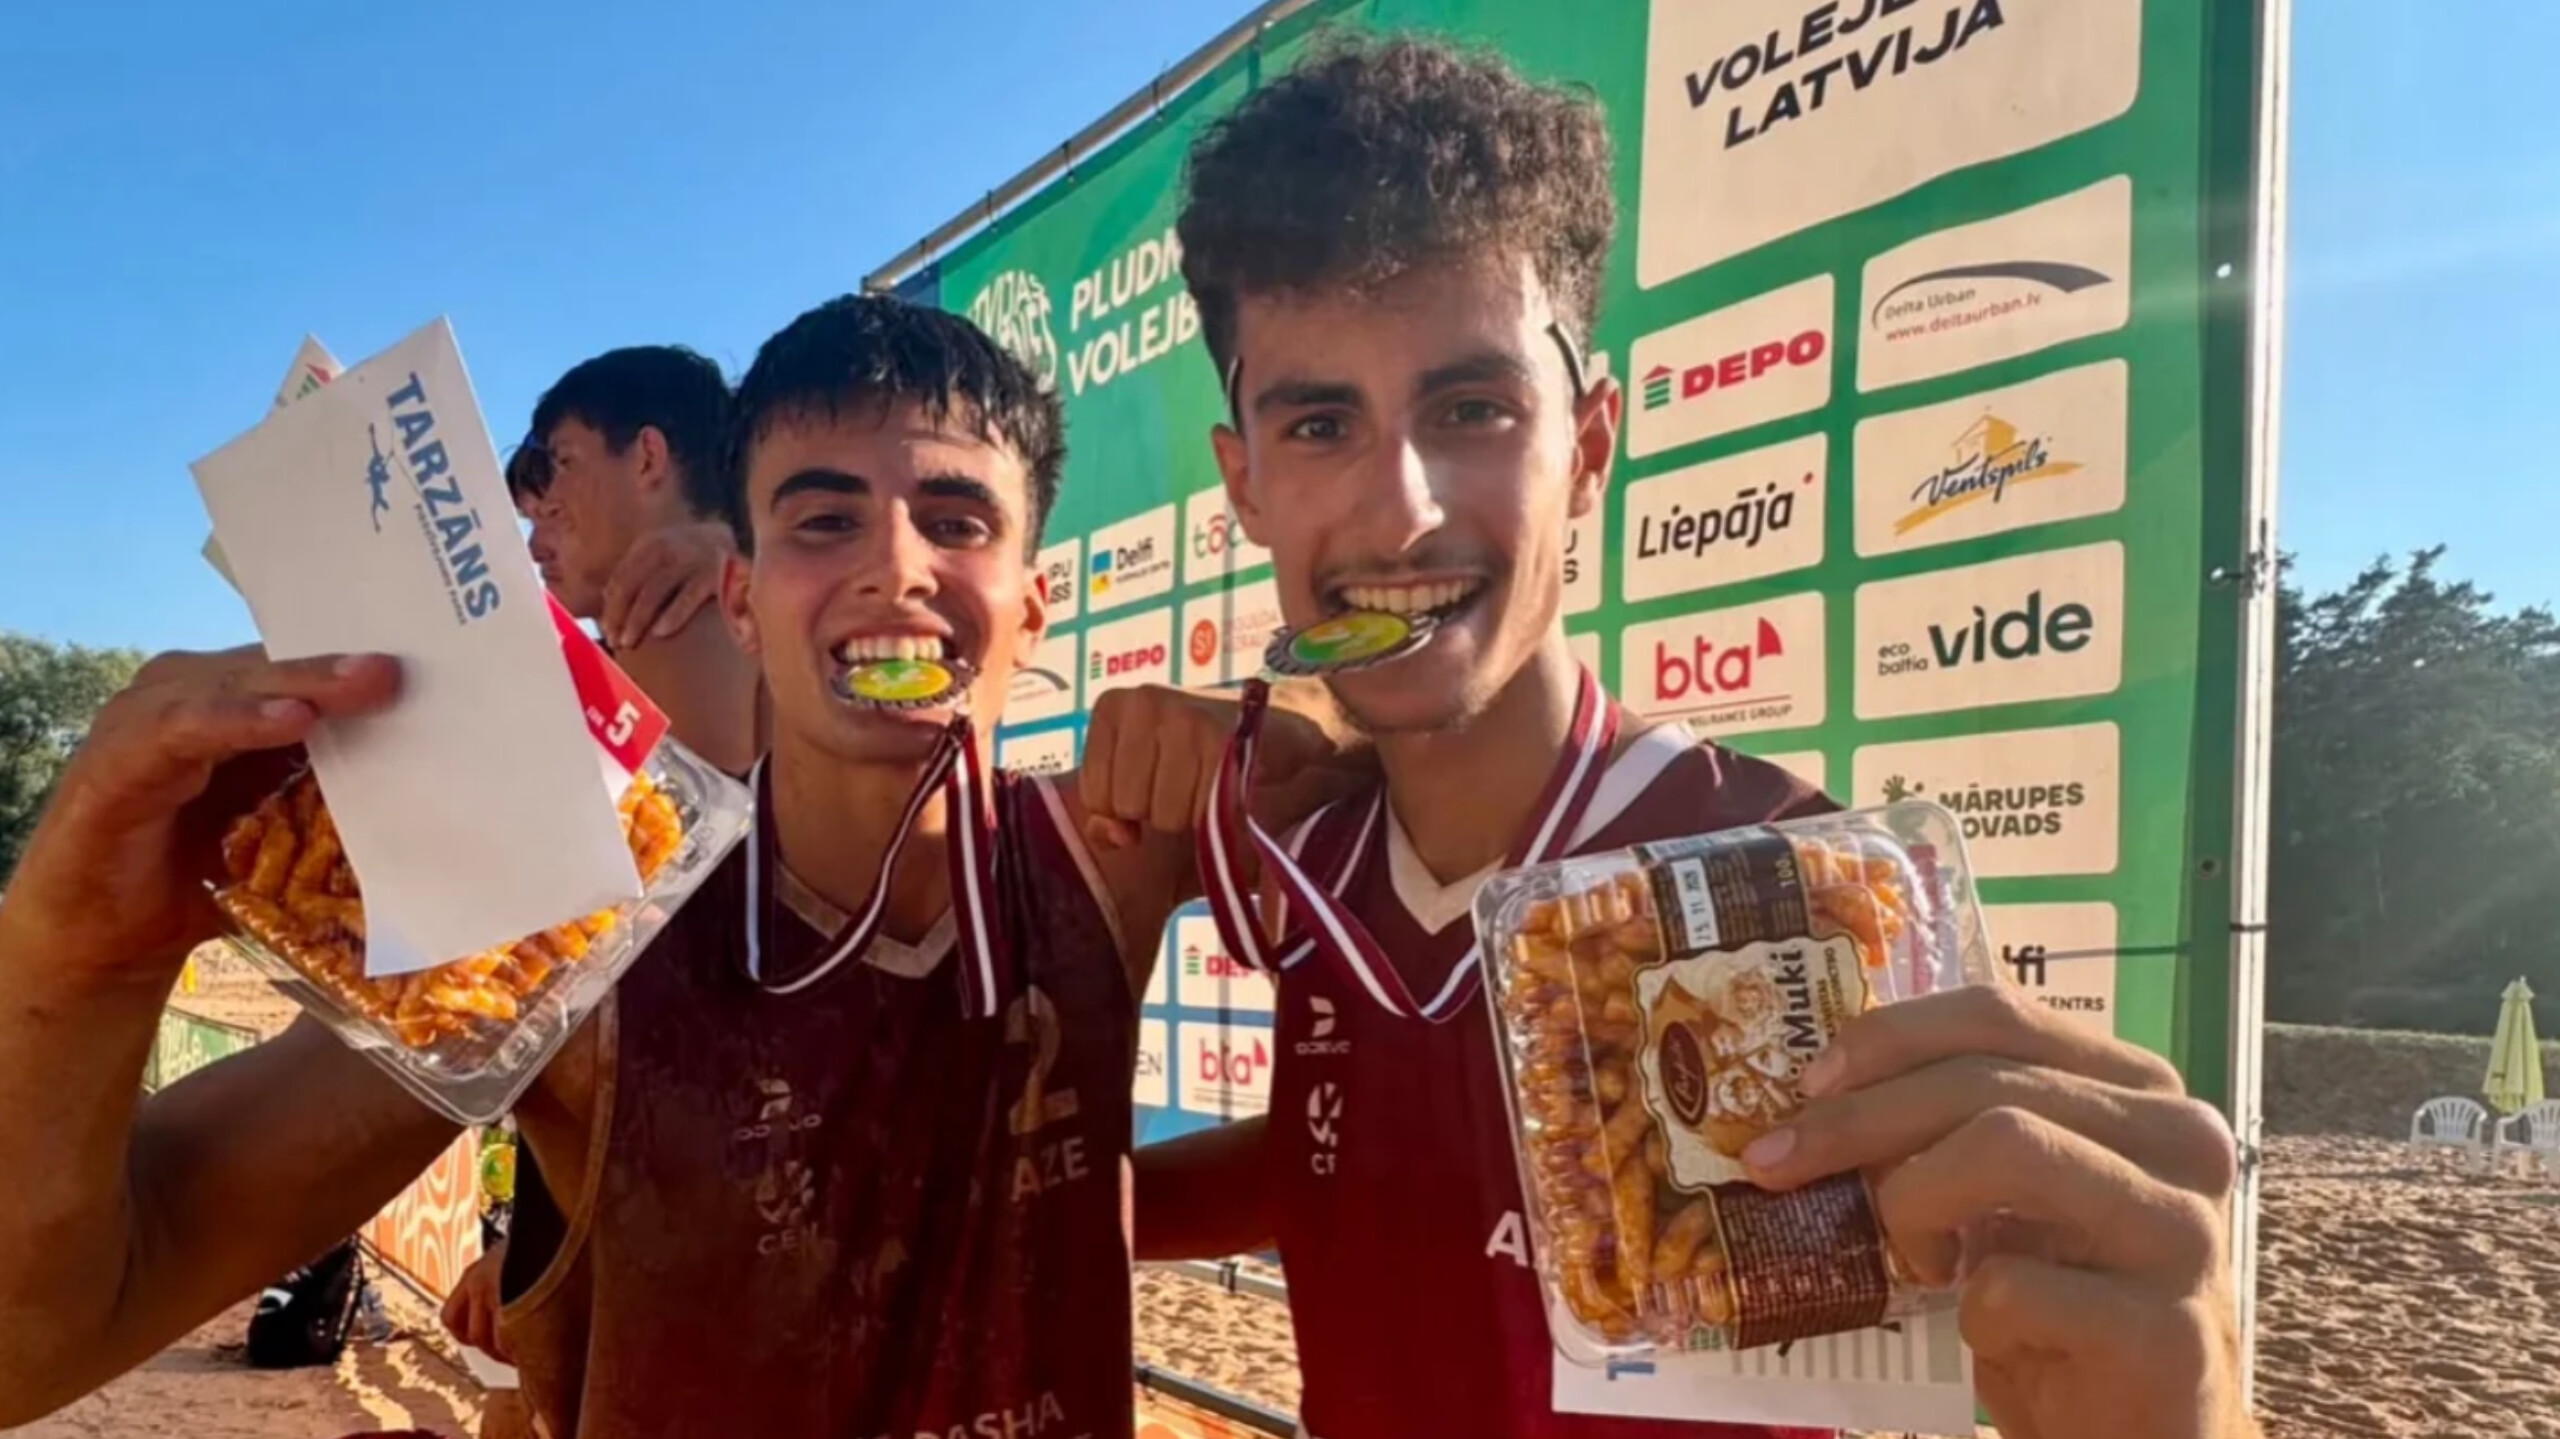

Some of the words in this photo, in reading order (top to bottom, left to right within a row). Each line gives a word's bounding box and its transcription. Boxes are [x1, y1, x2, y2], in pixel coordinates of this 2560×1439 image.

[1723, 0, 2005, 149] LATVIJA
[1885, 299, 1924, 320] Delta
[1927, 287, 1976, 309] Urban
[1885, 293, 2042, 342] www.deltaurban.lv
[1681, 329, 1825, 400] DEPO
[385, 371, 501, 619] TARZĀNS
[1911, 437, 2048, 506] Ventspils
[1637, 482, 1795, 559] Liepāja
[1106, 644, 1166, 678] DEPO
[1656, 634, 1752, 701] bta
[1877, 642, 1911, 659] eco
[1877, 655, 1929, 676] baltia
[1687, 708, 1747, 728] NSURANCE
[1749, 703, 1793, 721] GROUP
[1939, 782, 2085, 814] MĀRUPES
[1962, 812, 2062, 839] OVADS
[1769, 949, 1820, 1048] Muki
[1004, 984, 1080, 1136] 2
[1200, 1037, 1254, 1086] bta
[1010, 1136, 1090, 1202] AZE
[914, 1391, 1065, 1439] SHA
